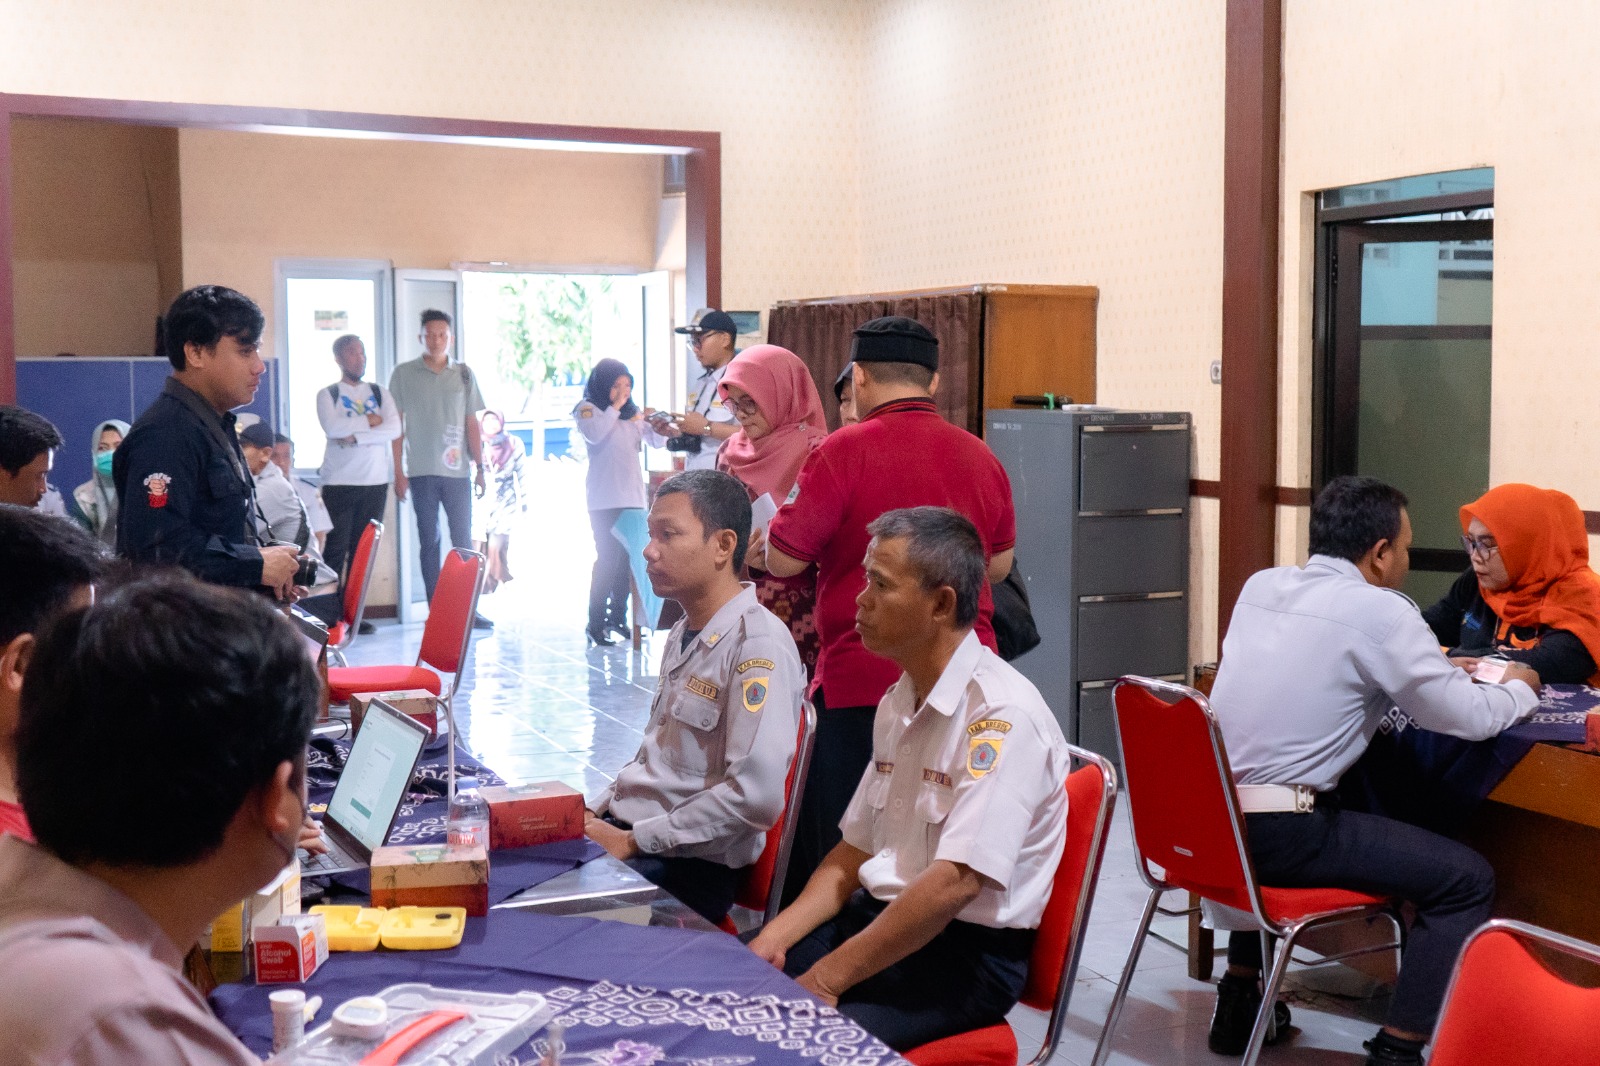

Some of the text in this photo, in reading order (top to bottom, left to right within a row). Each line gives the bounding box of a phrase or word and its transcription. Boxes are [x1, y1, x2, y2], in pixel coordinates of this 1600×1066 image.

[985, 720, 1009, 732] BREBES
[260, 948, 292, 957] Alcohol
[260, 956, 284, 965] Swab
